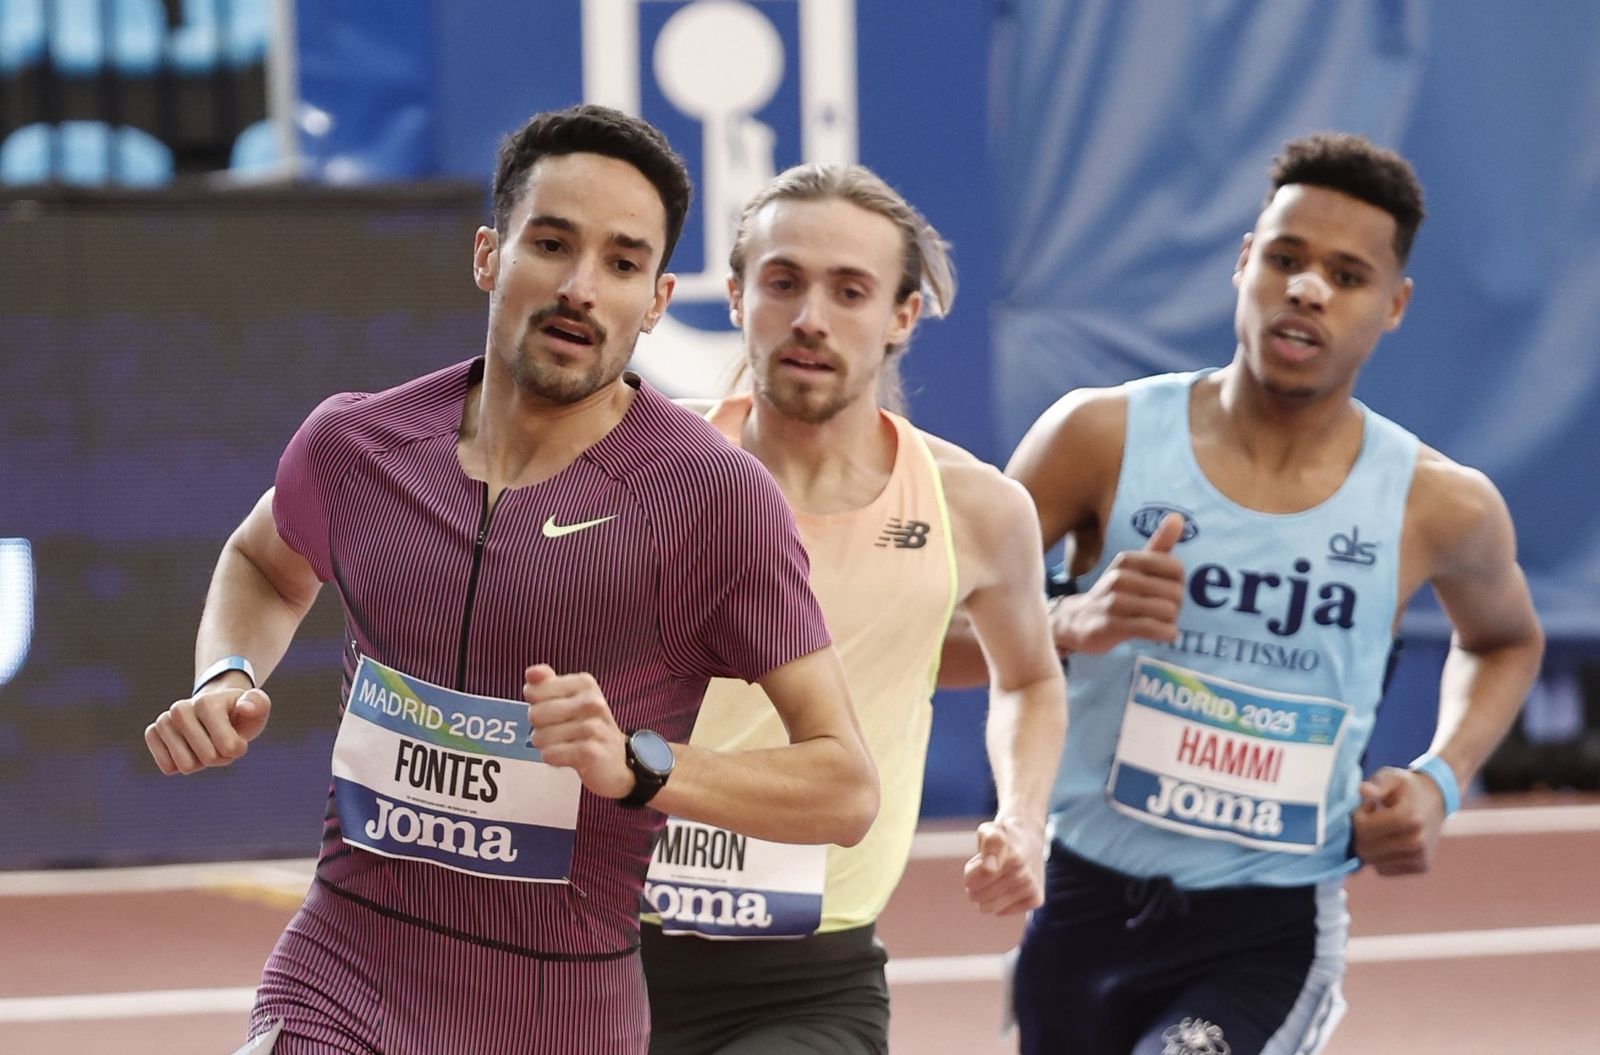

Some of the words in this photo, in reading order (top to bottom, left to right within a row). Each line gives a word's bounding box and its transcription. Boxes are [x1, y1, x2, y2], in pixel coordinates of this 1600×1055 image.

[1188, 556, 1357, 637] erja
[358, 678, 444, 729] MADRID
[448, 711, 518, 745] 2025
[1136, 673, 1236, 721] MADRID
[1239, 705, 1298, 737] 2025
[394, 738, 501, 803] FONTES
[1176, 725, 1285, 784] HAMMI
[365, 797, 518, 862] Joma
[1146, 776, 1283, 836] Joma
[657, 825, 747, 871] MIRON
